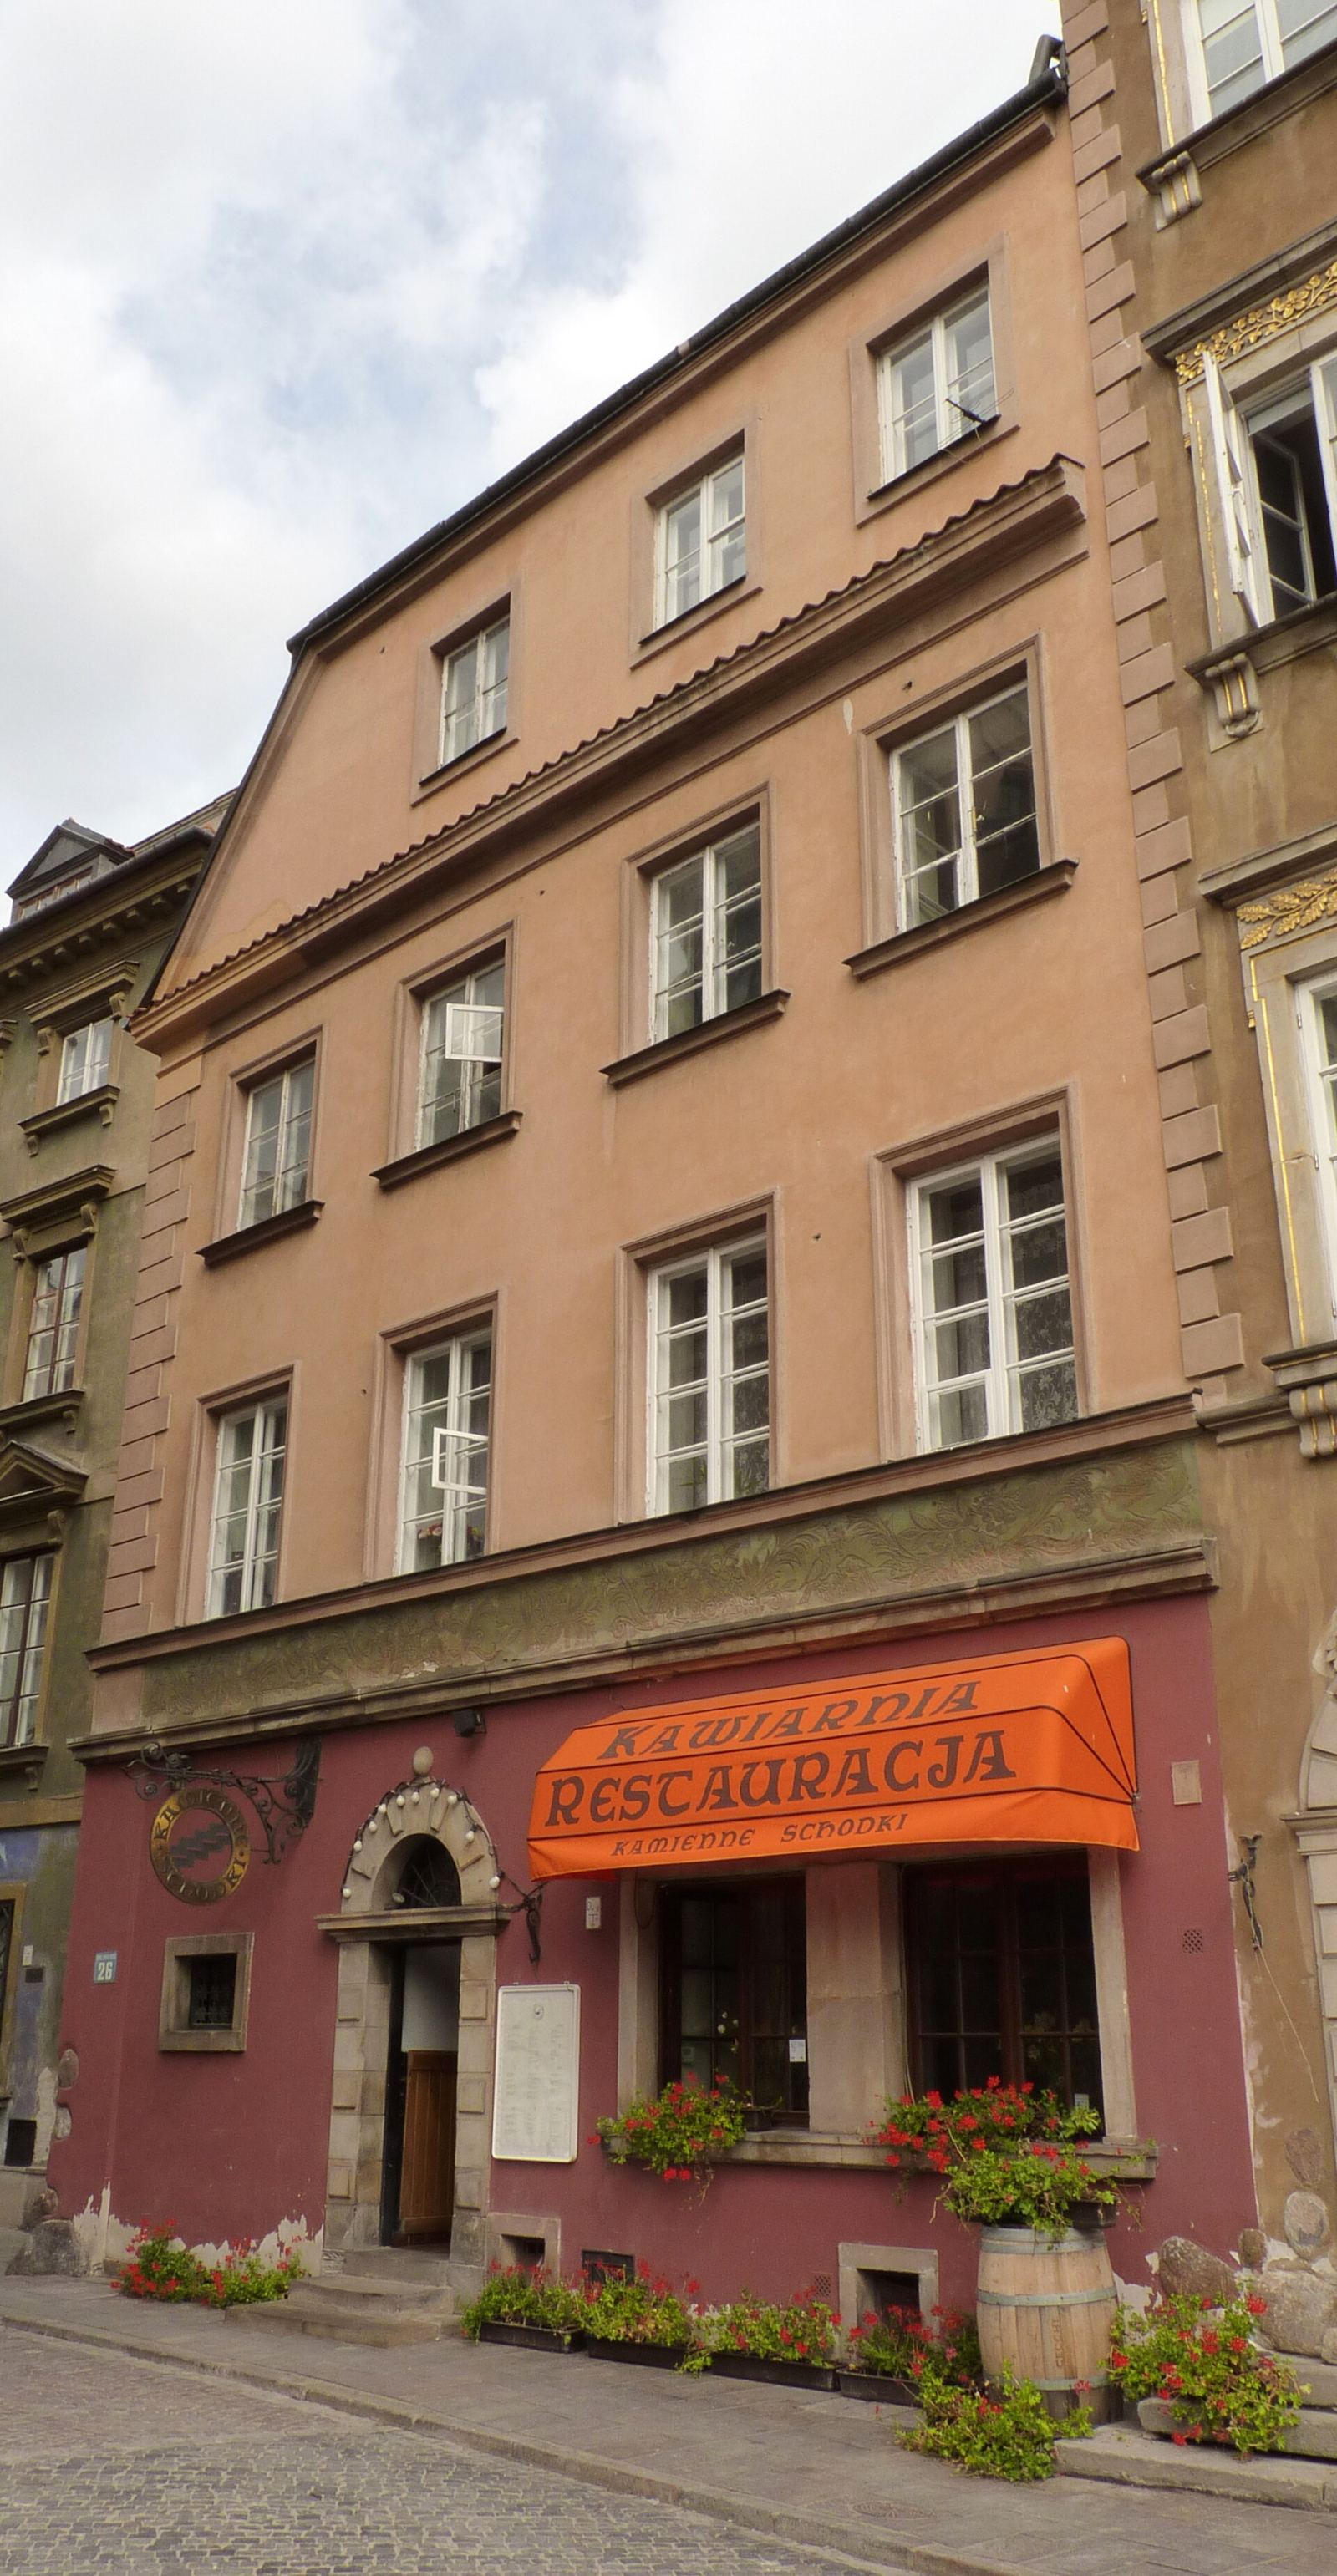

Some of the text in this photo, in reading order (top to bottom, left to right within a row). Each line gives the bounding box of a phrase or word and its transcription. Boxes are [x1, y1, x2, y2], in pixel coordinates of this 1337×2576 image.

[596, 1680, 981, 1761] KAWIARNIA
[545, 1730, 1017, 1827] RESTAURACJA
[611, 1813, 908, 1857] KAMIENNE SCHODKI
[97, 1961, 113, 1981] 26
